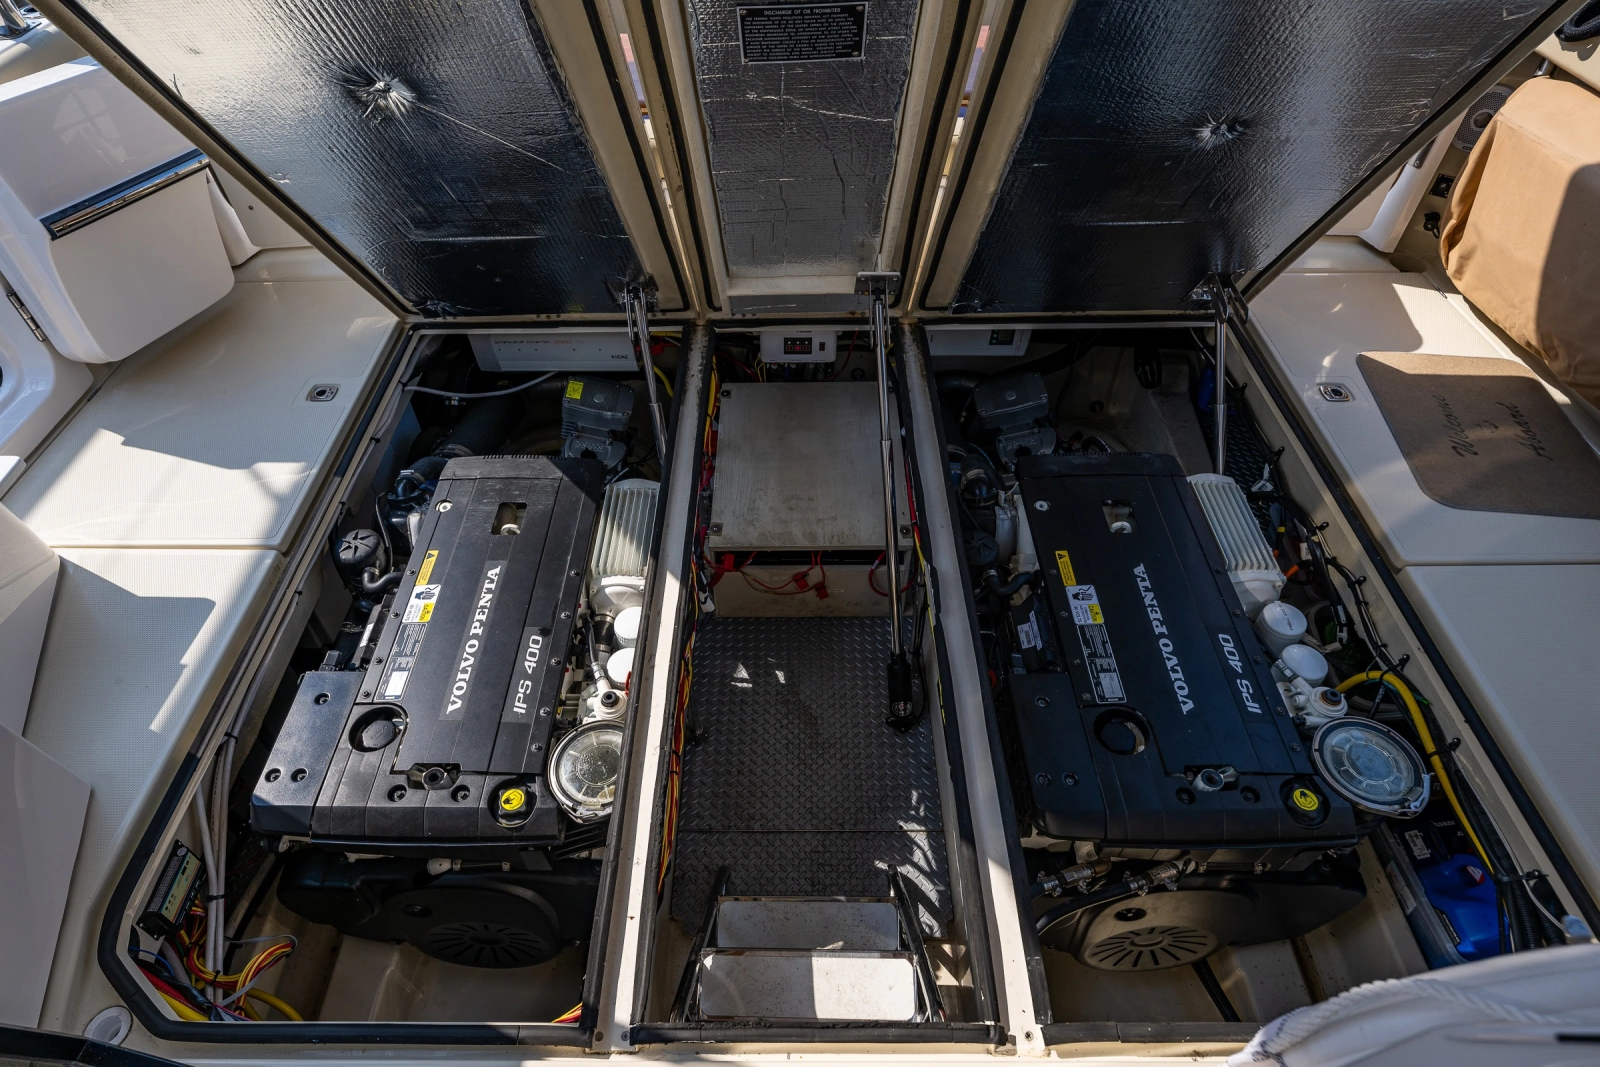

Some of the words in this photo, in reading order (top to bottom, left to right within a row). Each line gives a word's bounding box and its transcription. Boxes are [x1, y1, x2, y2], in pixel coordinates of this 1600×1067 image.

[1432, 394, 1478, 458] Welcome
[1495, 401, 1554, 462] Aboard
[1088, 605, 1097, 621] CAUTION
[1133, 562, 1168, 635] PENTA
[446, 639, 479, 712] VOLVO
[470, 565, 501, 636] PENTA
[1218, 633, 1243, 674] 400
[513, 679, 532, 714] IPS
[524, 635, 543, 674] 400
[1158, 637, 1195, 715] VOLVO
[1236, 678, 1262, 714] IPS
